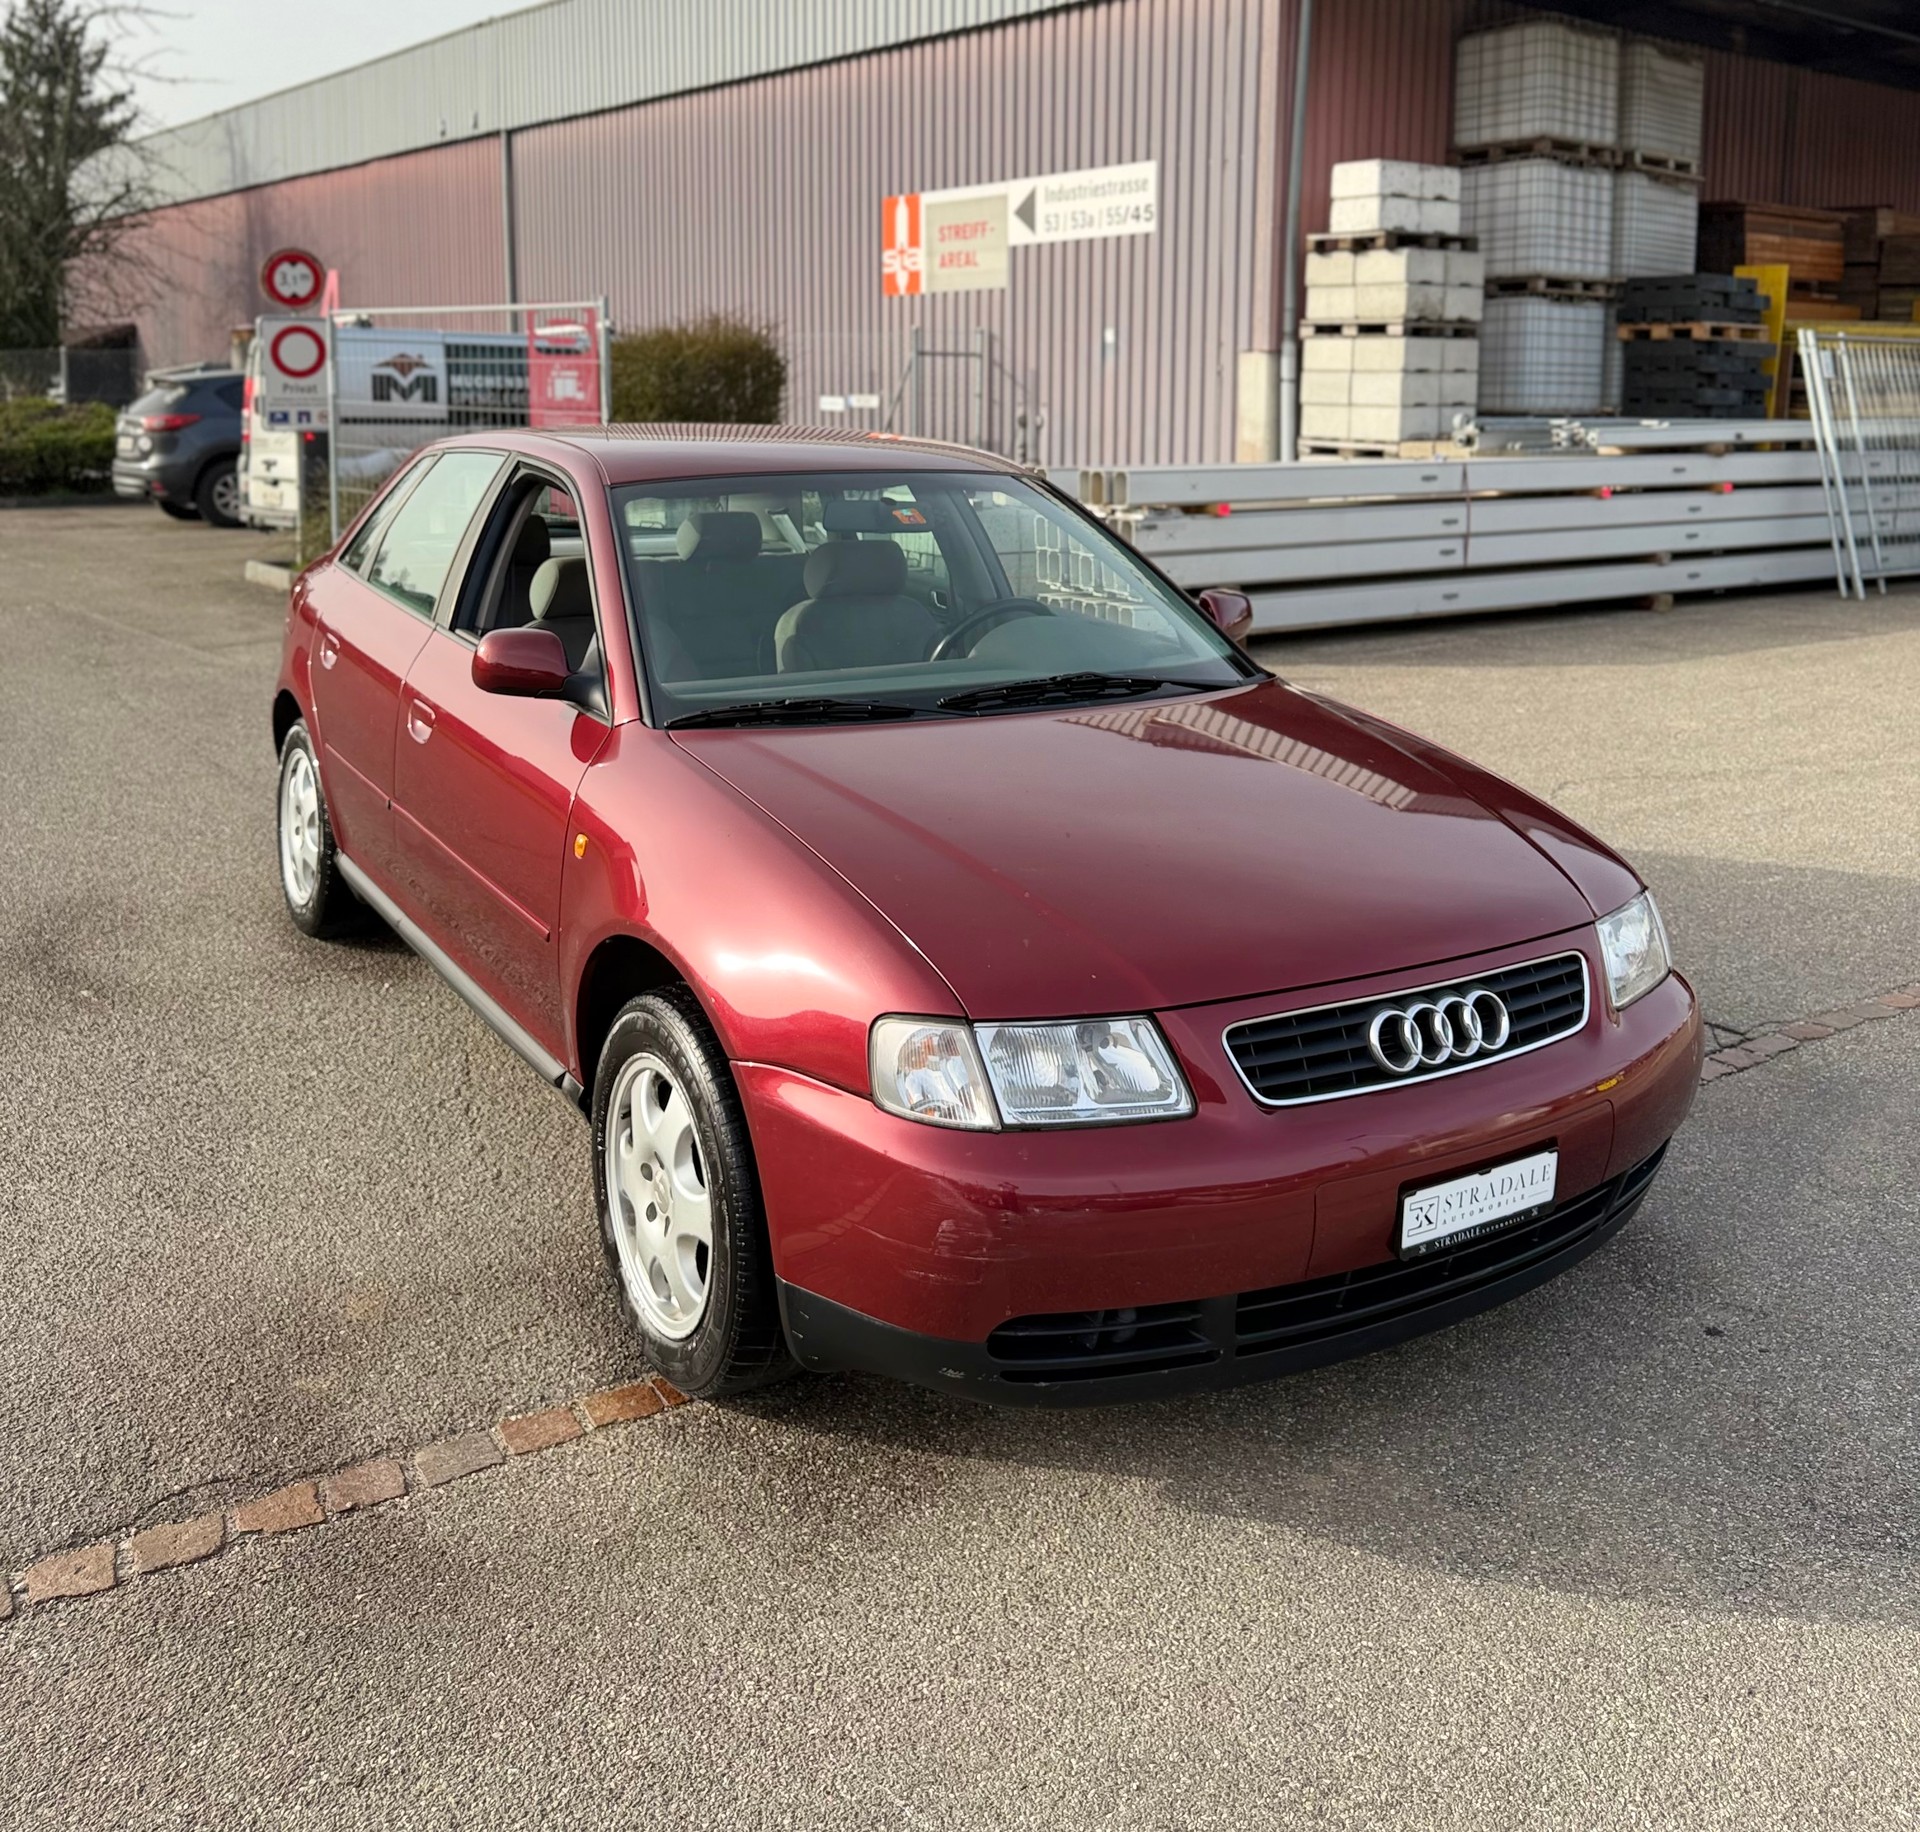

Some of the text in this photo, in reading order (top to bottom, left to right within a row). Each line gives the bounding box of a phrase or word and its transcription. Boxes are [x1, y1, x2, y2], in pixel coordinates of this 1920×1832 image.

[1044, 178, 1149, 204] Industriestrasse
[938, 220, 996, 243] STREIFF-
[1044, 212, 1060, 232] 53
[1071, 209, 1094, 230] 53a
[939, 249, 979, 269] AREAL
[282, 382, 319, 395] Privat
[1443, 1162, 1552, 1213] STRADALE
[1442, 1193, 1526, 1226] AUTOMOBILE
[1434, 1226, 1481, 1250] STRADALE
